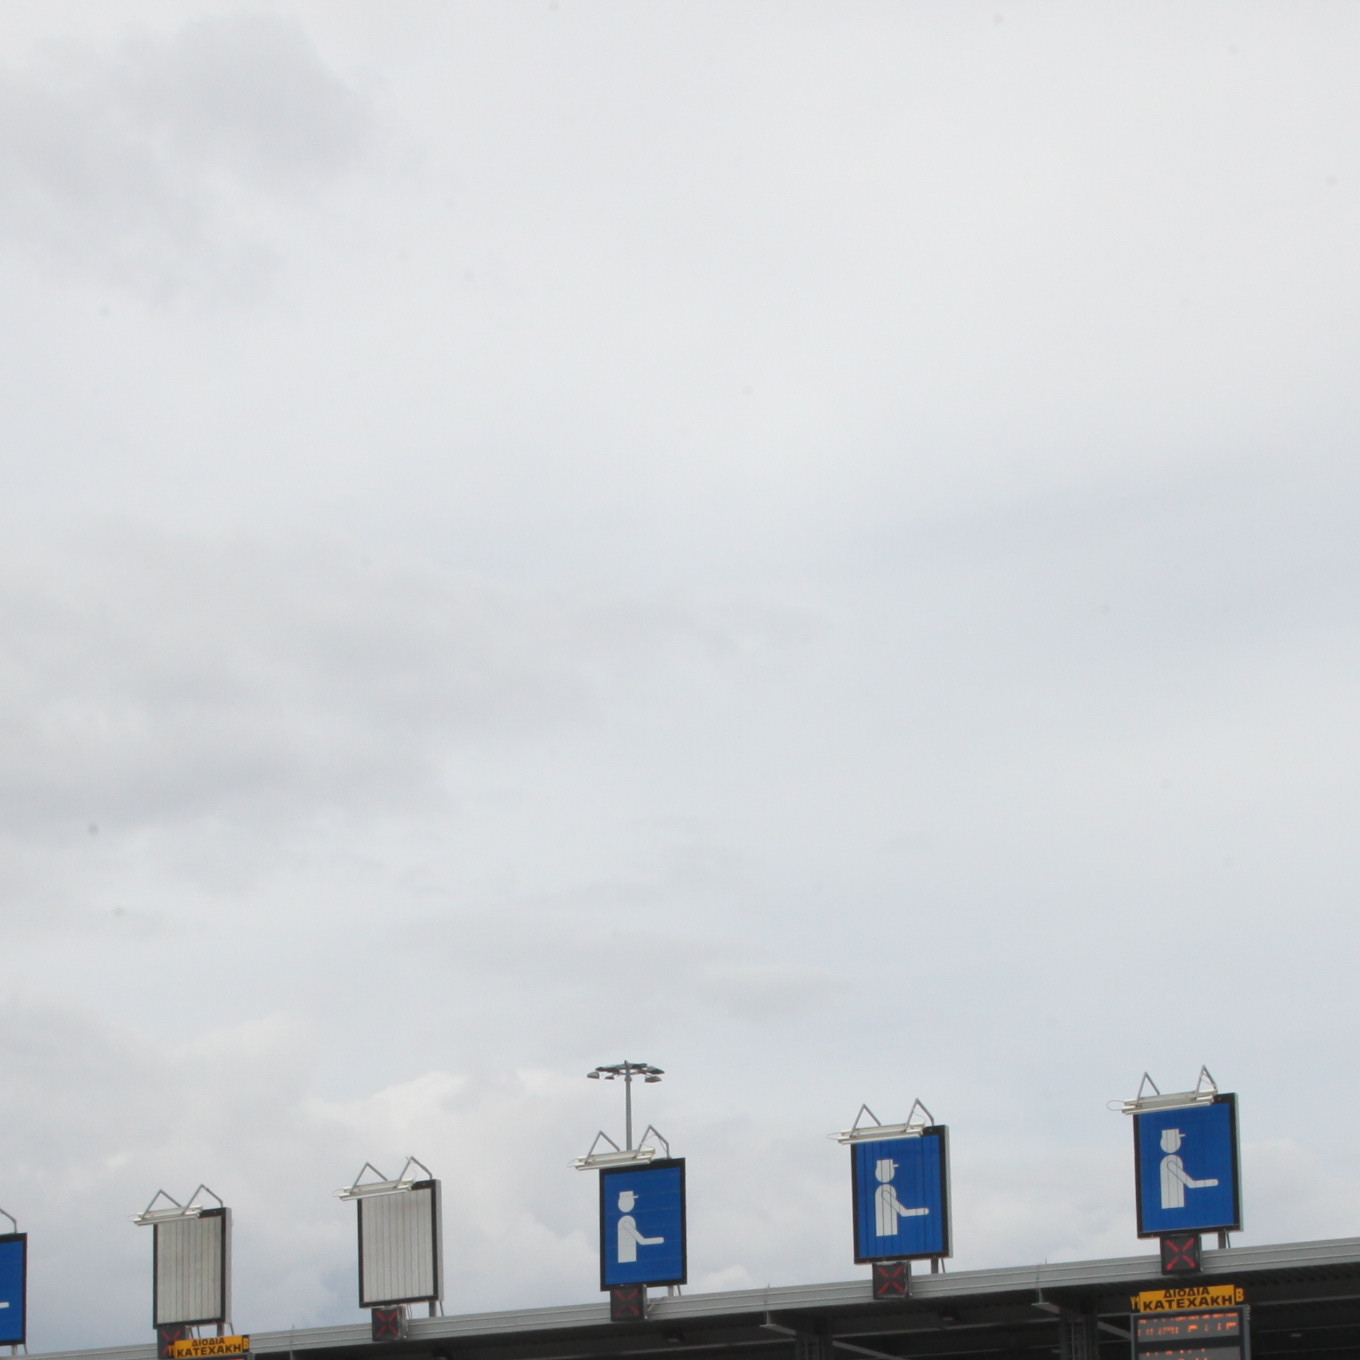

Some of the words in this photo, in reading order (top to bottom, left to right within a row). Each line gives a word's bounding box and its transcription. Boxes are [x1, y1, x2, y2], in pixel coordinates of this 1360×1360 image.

[1164, 1287, 1210, 1298] ΔΙΟΔΙΑ
[1143, 1295, 1232, 1311] ΚΑΤΕΧΑΚΗ
[176, 1343, 241, 1358] ΚΑΤΕΧΑΚΗ
